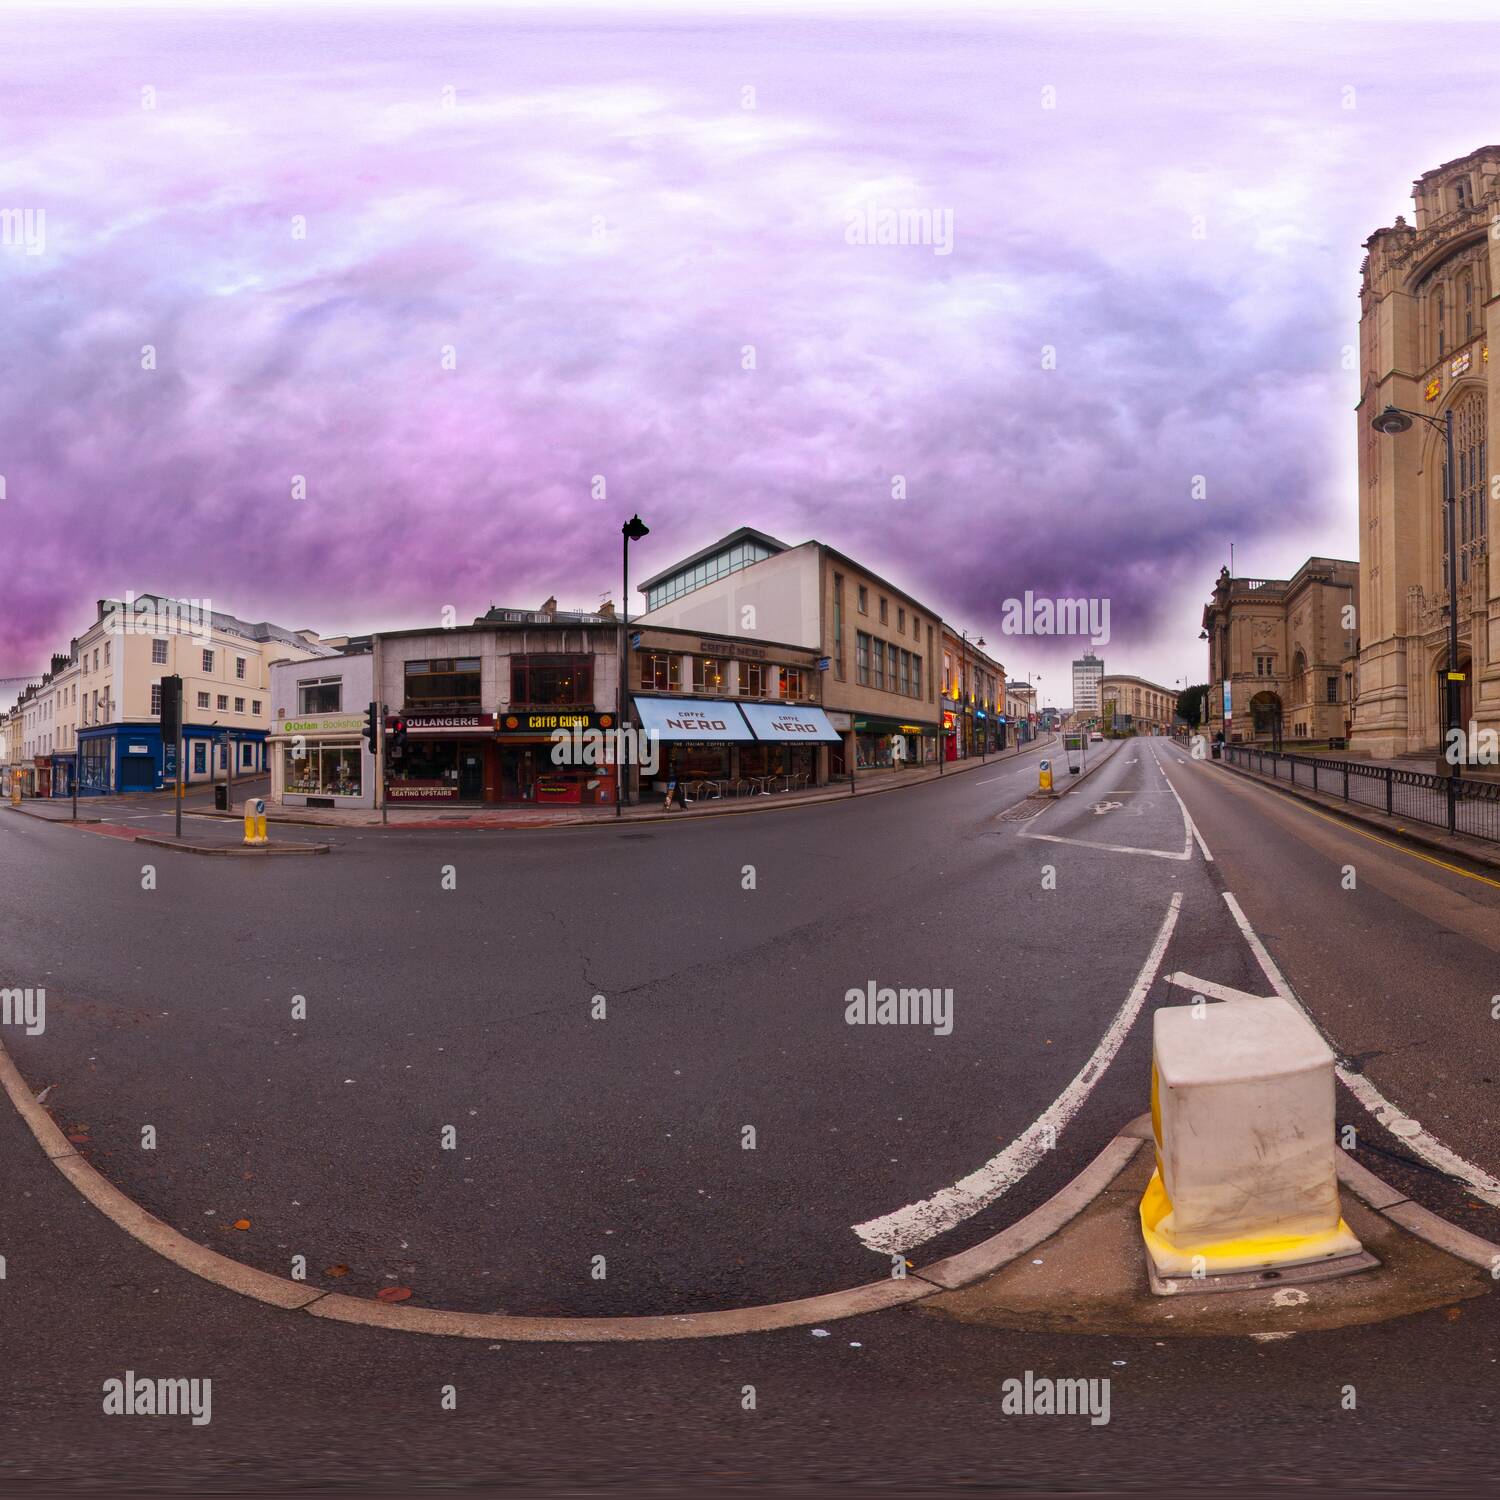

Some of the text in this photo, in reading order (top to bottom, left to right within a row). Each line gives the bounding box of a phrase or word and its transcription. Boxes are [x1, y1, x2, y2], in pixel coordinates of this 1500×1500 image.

[293, 719, 362, 731] Oxfam Bookshop
[666, 719, 727, 731] NERO
[771, 721, 818, 733] NERO
